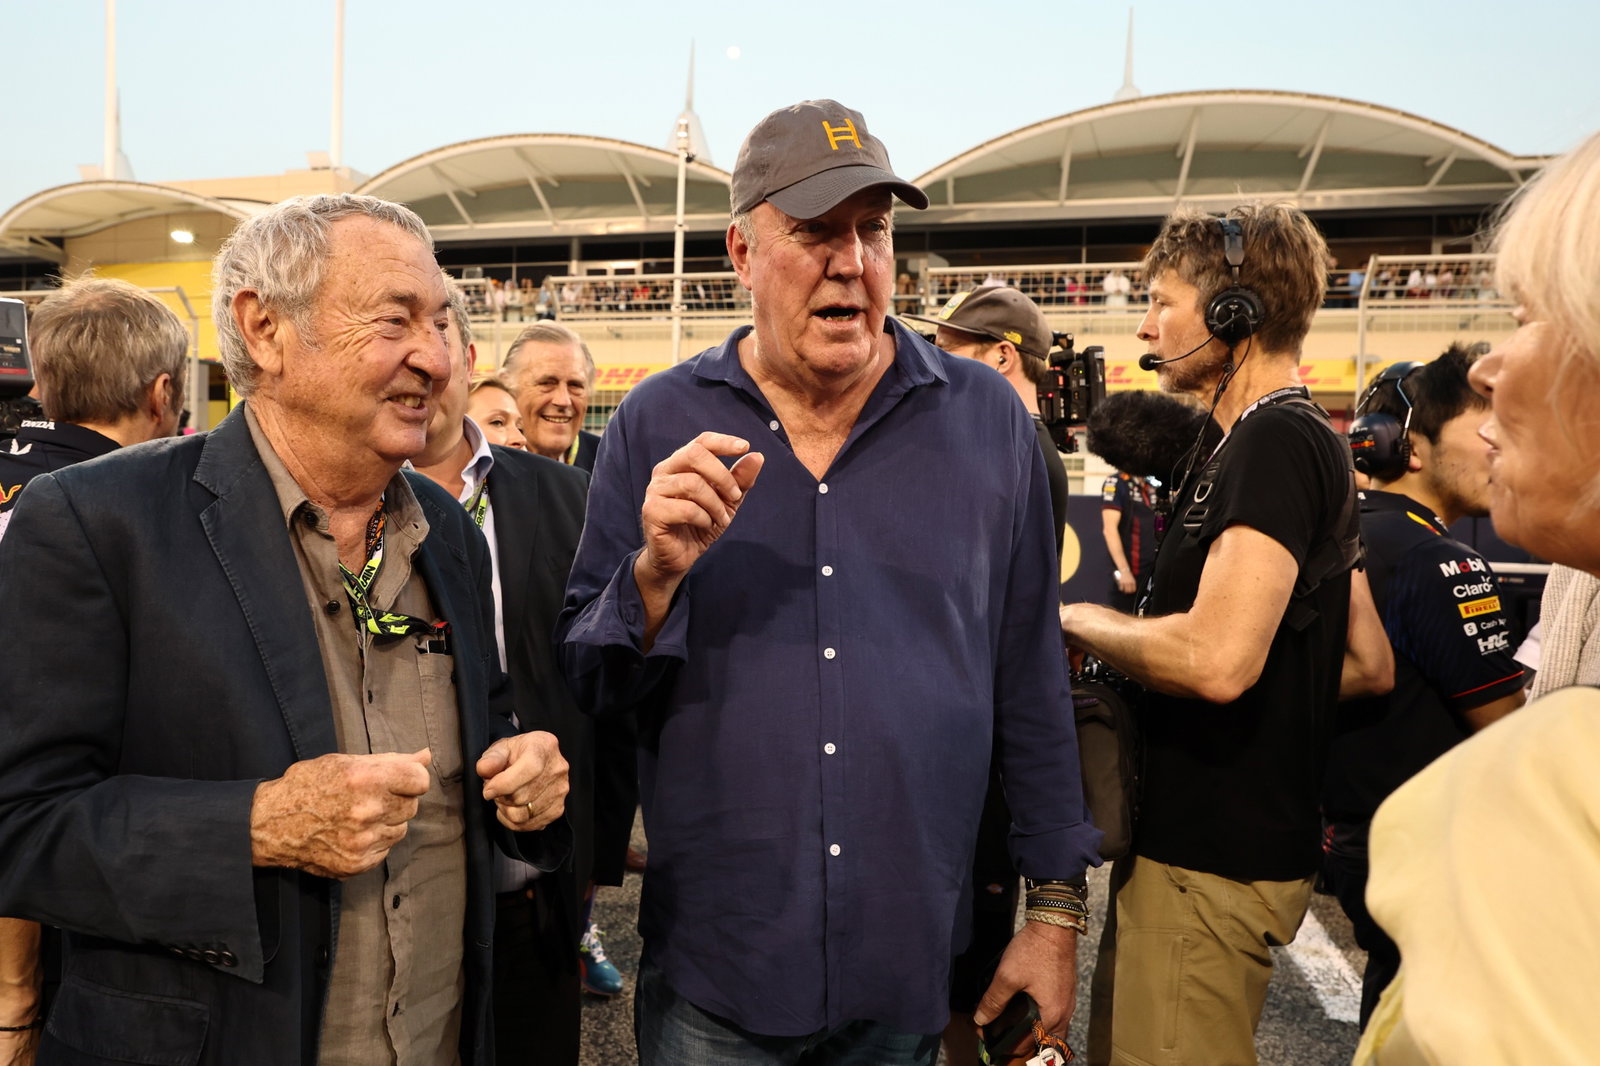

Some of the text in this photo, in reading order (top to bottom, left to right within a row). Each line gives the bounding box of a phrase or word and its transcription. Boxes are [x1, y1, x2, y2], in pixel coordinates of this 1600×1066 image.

[822, 118, 863, 150] H
[20, 419, 56, 430] ONDA
[1452, 582, 1493, 598] Claro
